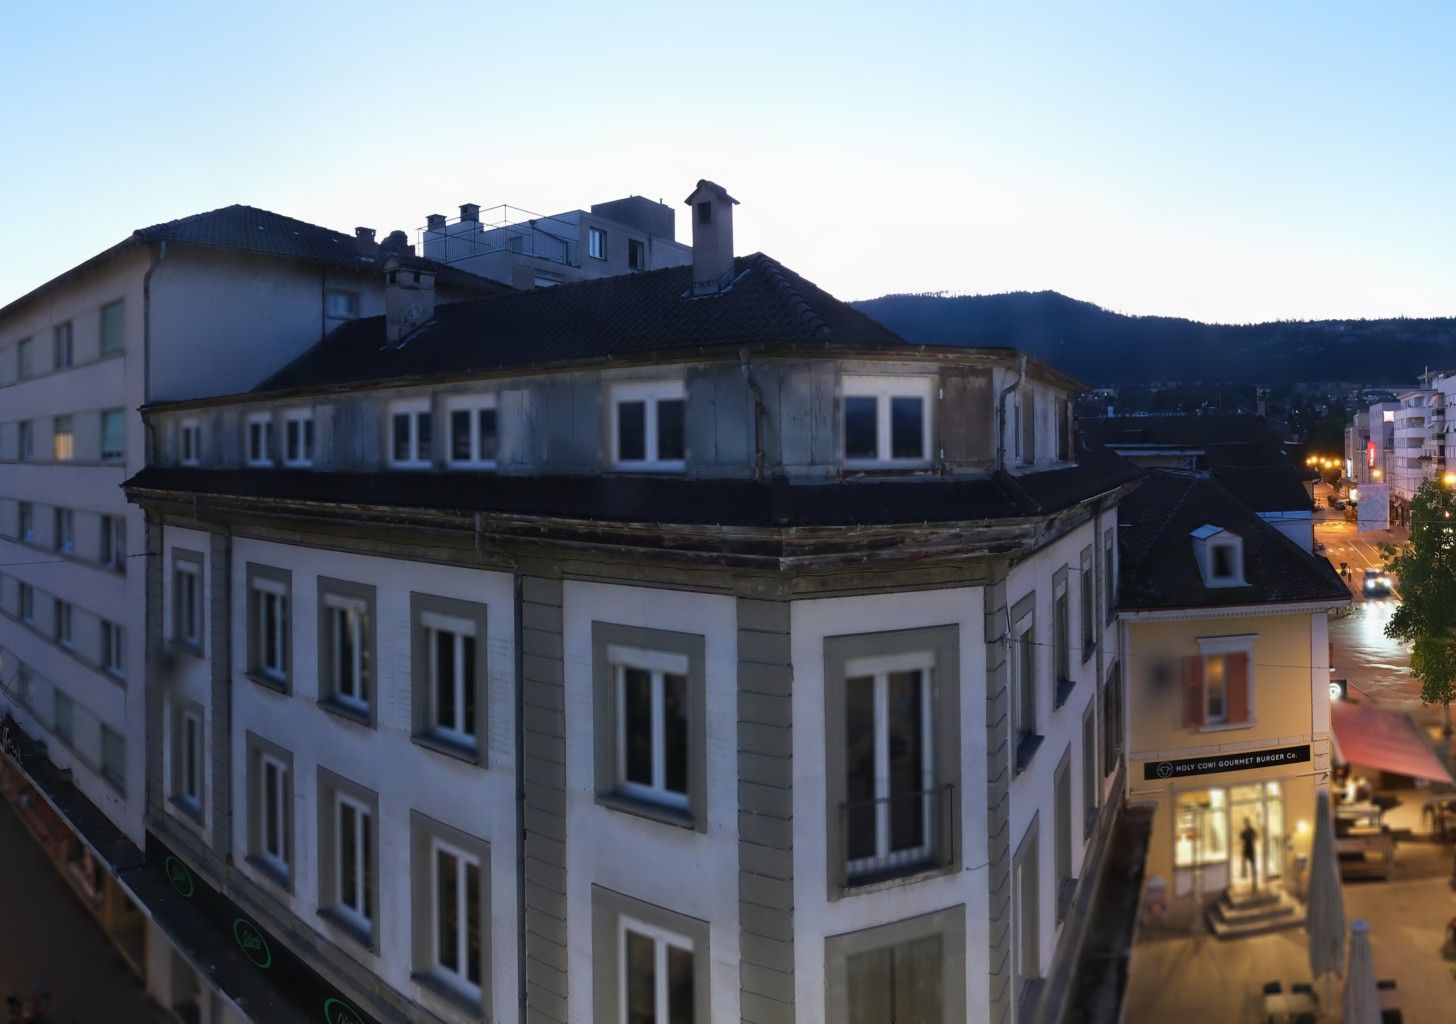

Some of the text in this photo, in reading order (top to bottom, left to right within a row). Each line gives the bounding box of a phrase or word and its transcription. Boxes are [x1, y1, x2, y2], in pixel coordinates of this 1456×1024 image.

[1176, 752, 1298, 772] HOLY COW! GOURMET BURGER Co.
